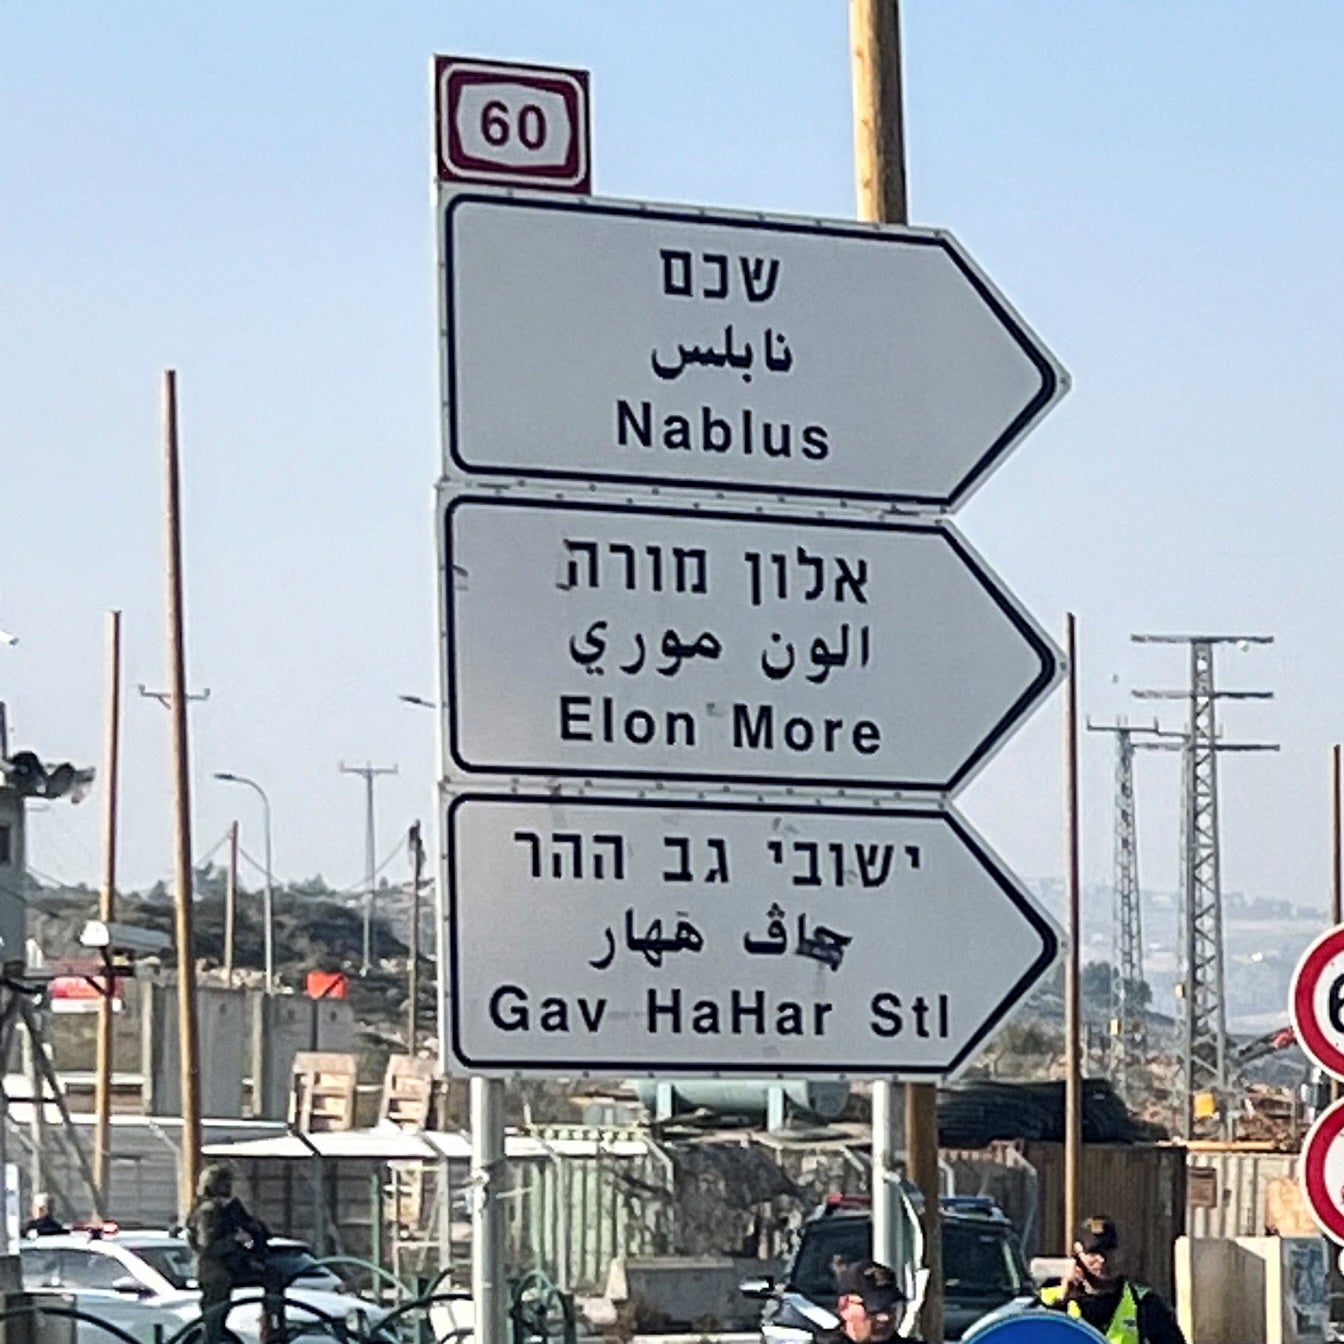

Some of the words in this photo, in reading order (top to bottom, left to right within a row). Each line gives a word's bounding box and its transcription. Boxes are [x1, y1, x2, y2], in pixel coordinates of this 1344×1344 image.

[481, 101, 546, 150] 60
[660, 249, 779, 302] שכם
[652, 325, 792, 383] نابلس
[617, 400, 828, 460] Nablus
[561, 540, 707, 594] מורה
[745, 546, 868, 606] אלון
[570, 621, 721, 676] موري
[762, 624, 869, 684] الون
[560, 695, 695, 745] Elon
[733, 704, 880, 754] More
[514, 832, 624, 879] ההר
[663, 837, 728, 883] גב
[767, 841, 920, 887] ישובי
[489, 985, 607, 1032] Gav
[648, 989, 832, 1035] HaHar
[871, 993, 948, 1038] Stl
